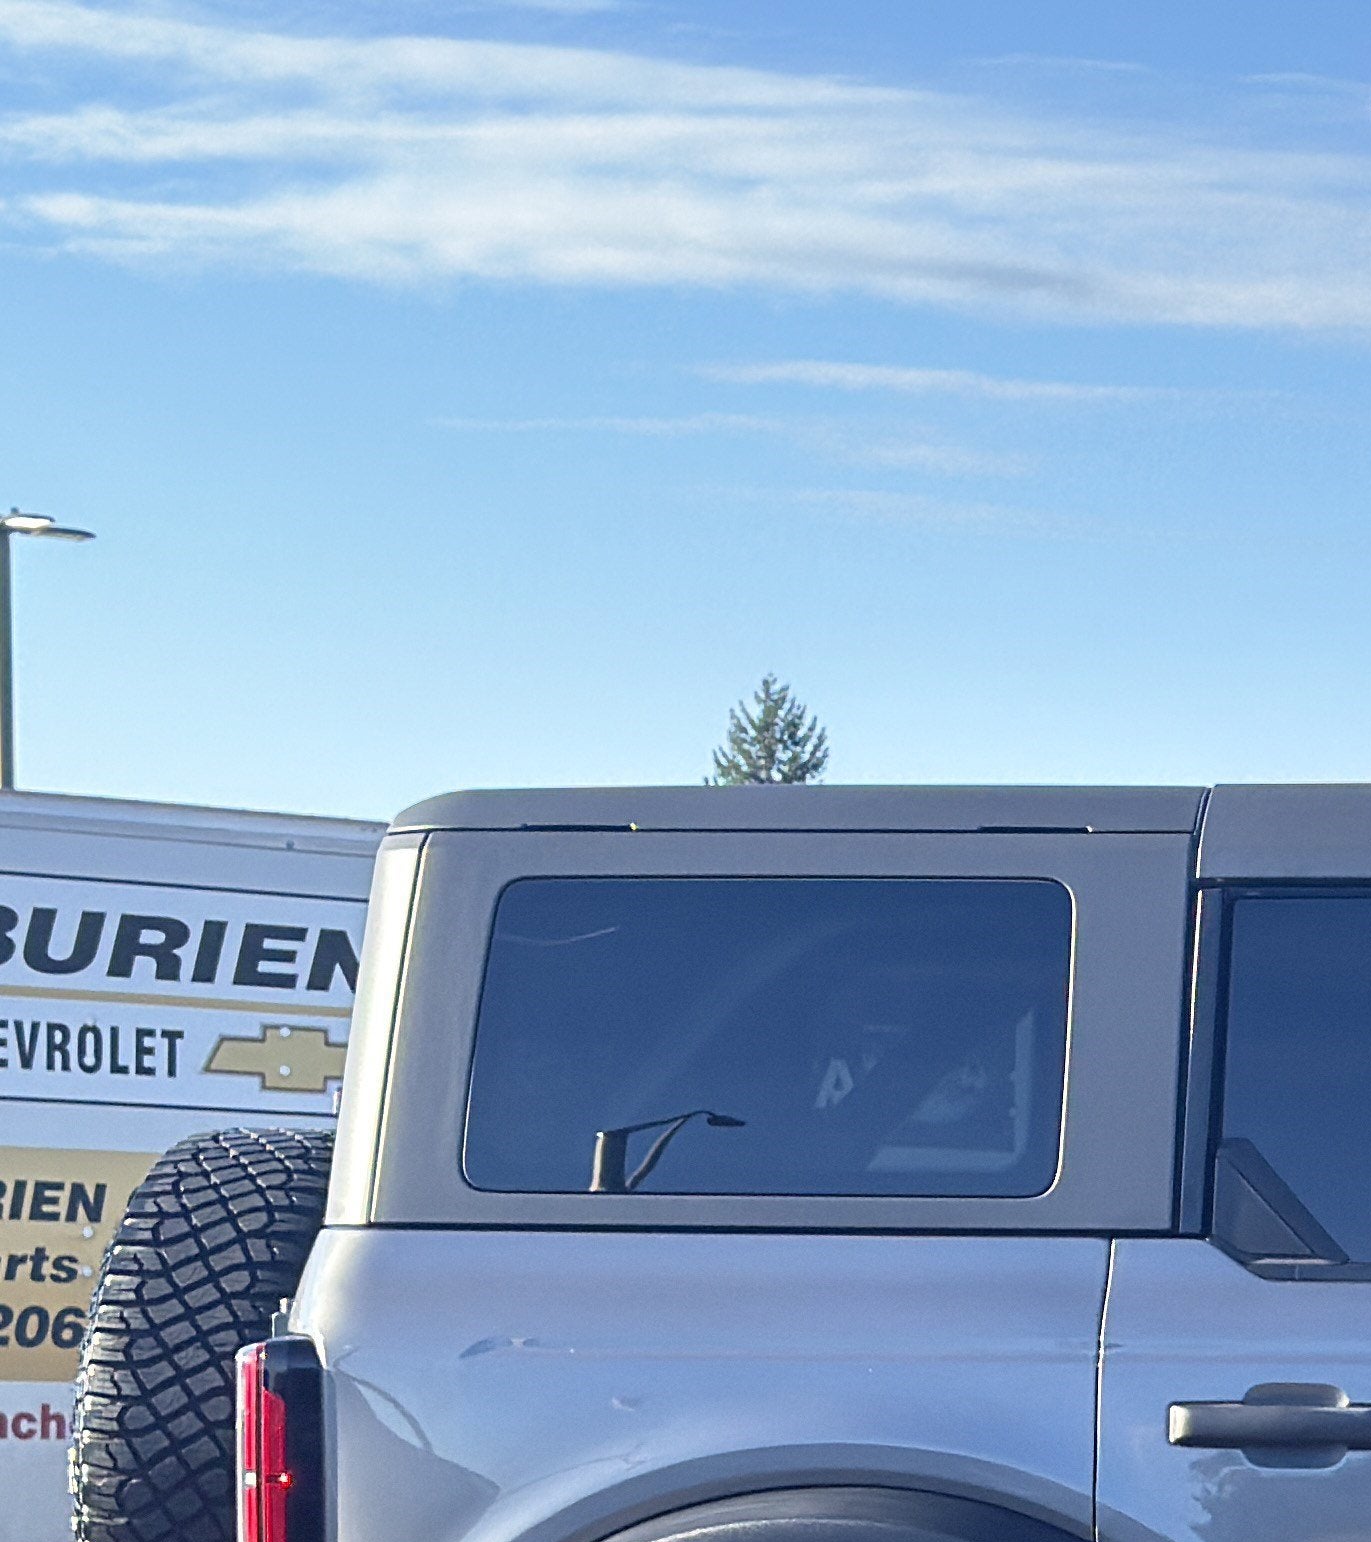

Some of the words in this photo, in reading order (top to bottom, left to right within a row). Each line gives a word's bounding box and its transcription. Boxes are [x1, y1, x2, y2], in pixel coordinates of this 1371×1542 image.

[0, 904, 358, 994] URIEN
[0, 1178, 107, 1223] IEN
[0, 1246, 79, 1283] rts
